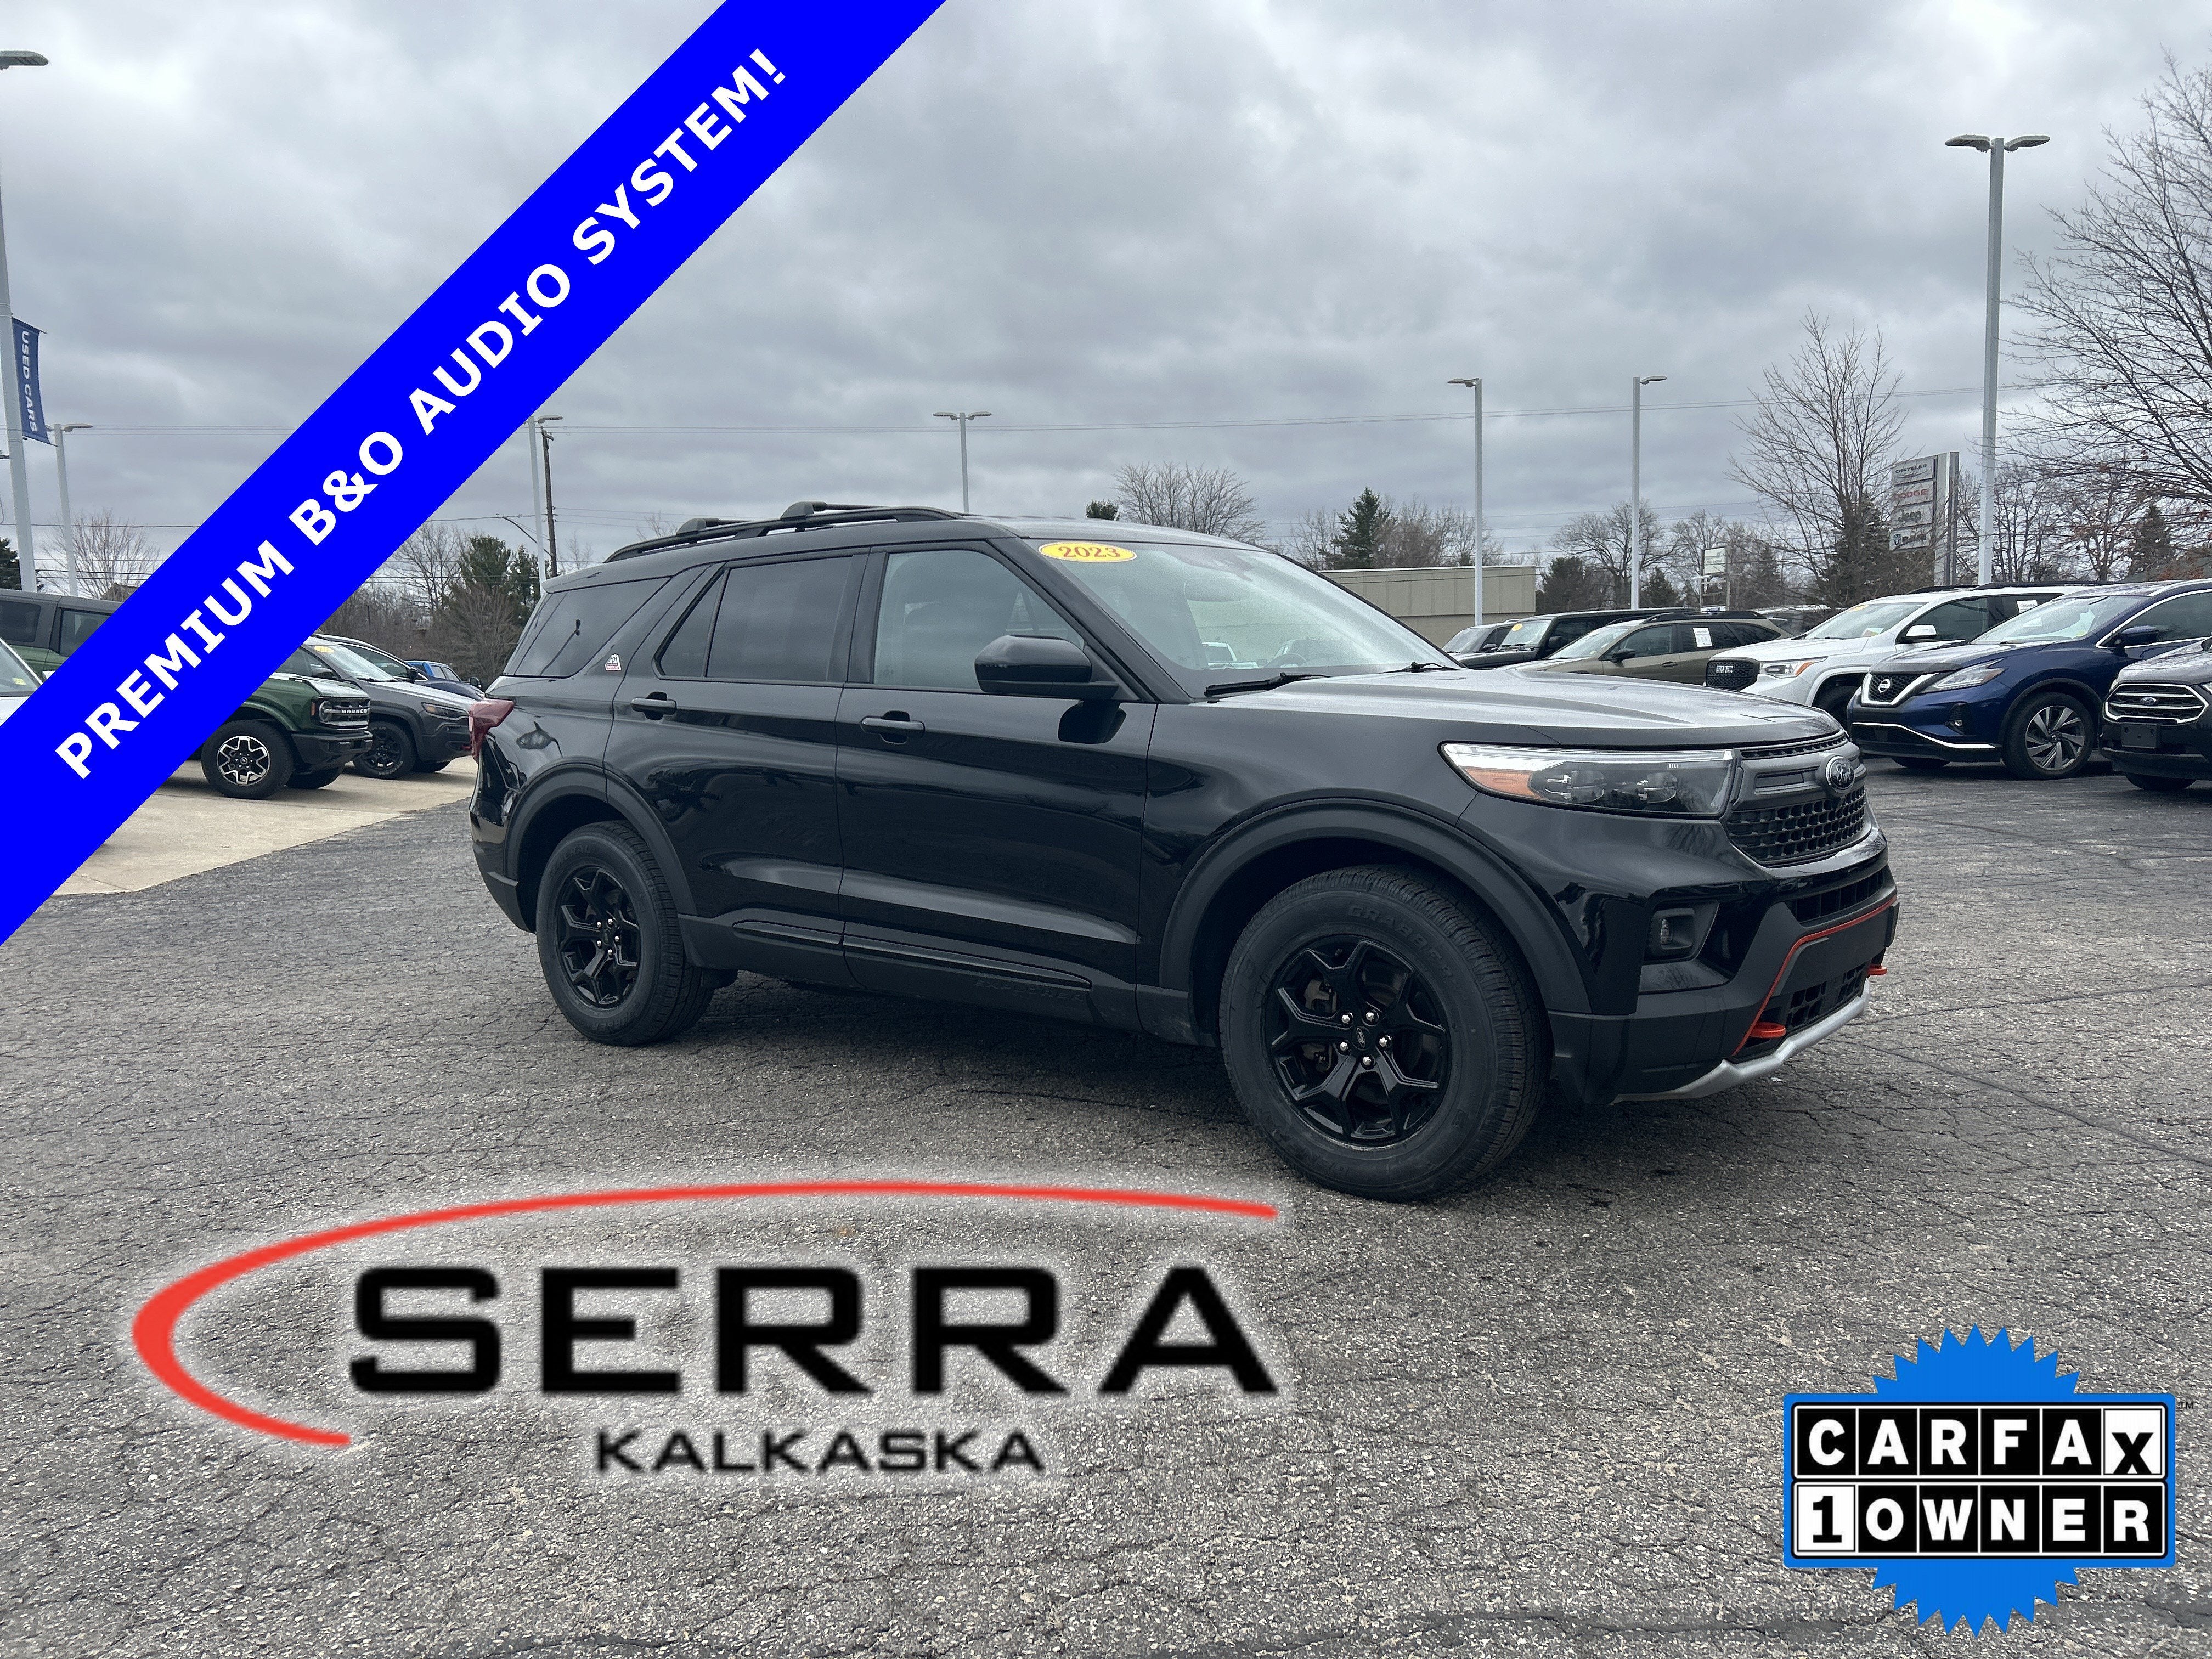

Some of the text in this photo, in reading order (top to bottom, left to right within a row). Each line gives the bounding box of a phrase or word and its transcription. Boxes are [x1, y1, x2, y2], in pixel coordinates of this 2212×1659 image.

[22, 330, 38, 432] USED CARS
[1895, 464, 1927, 473] CHRYSLER
[1894, 488, 1928, 500] DODGE
[1898, 509, 1922, 523] Jeep
[1058, 546, 1121, 557] 2023
